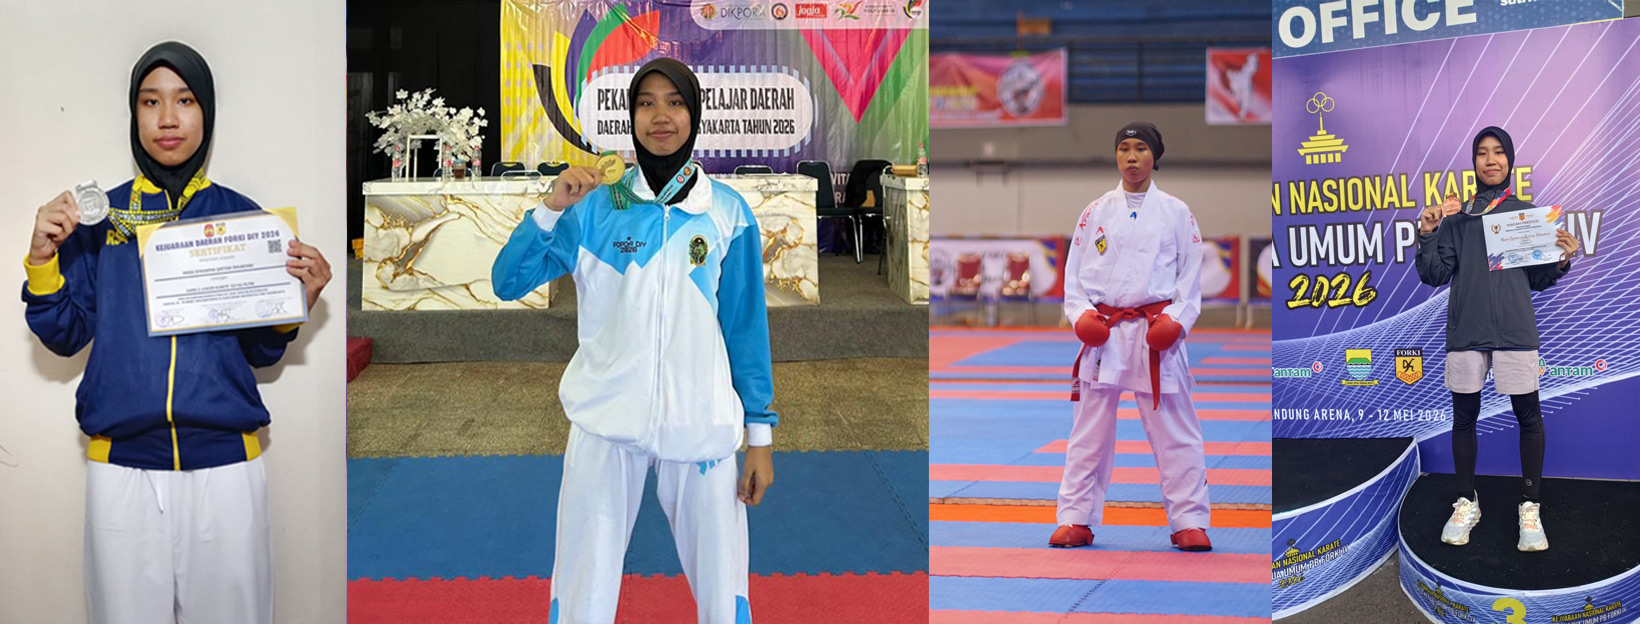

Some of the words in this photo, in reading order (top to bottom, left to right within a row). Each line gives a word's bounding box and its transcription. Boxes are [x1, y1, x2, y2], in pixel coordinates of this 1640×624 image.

[1278, 0, 1477, 48] OFFICE
[750, 88, 795, 110] DAERAH
[597, 119, 632, 135] DAERAH
[742, 119, 773, 134] TAHUN
[773, 119, 795, 134] 2026
[1289, 174, 1416, 215] NASIONAL
[155, 241, 194, 252] KEJUARAAN
[195, 237, 223, 247] DAERAH
[224, 234, 246, 244] FORKI
[247, 232, 259, 240] DIY
[261, 230, 280, 238] 2026
[189, 243, 246, 258] SERTIFIKAT
[1288, 222, 1384, 267] UMUM
[1287, 271, 1377, 308] 2026
[1313, 408, 1355, 422] ARENA,
[1358, 408, 1364, 420] 9
[1377, 408, 1389, 420] 12
[1393, 408, 1414, 421] MEI
[1418, 408, 1446, 421] 2026
[1282, 550, 1316, 567] NASIONAL
[1317, 539, 1341, 555] KARATE
[1283, 562, 1307, 577] UMUM
[1492, 597, 1527, 624] 3
